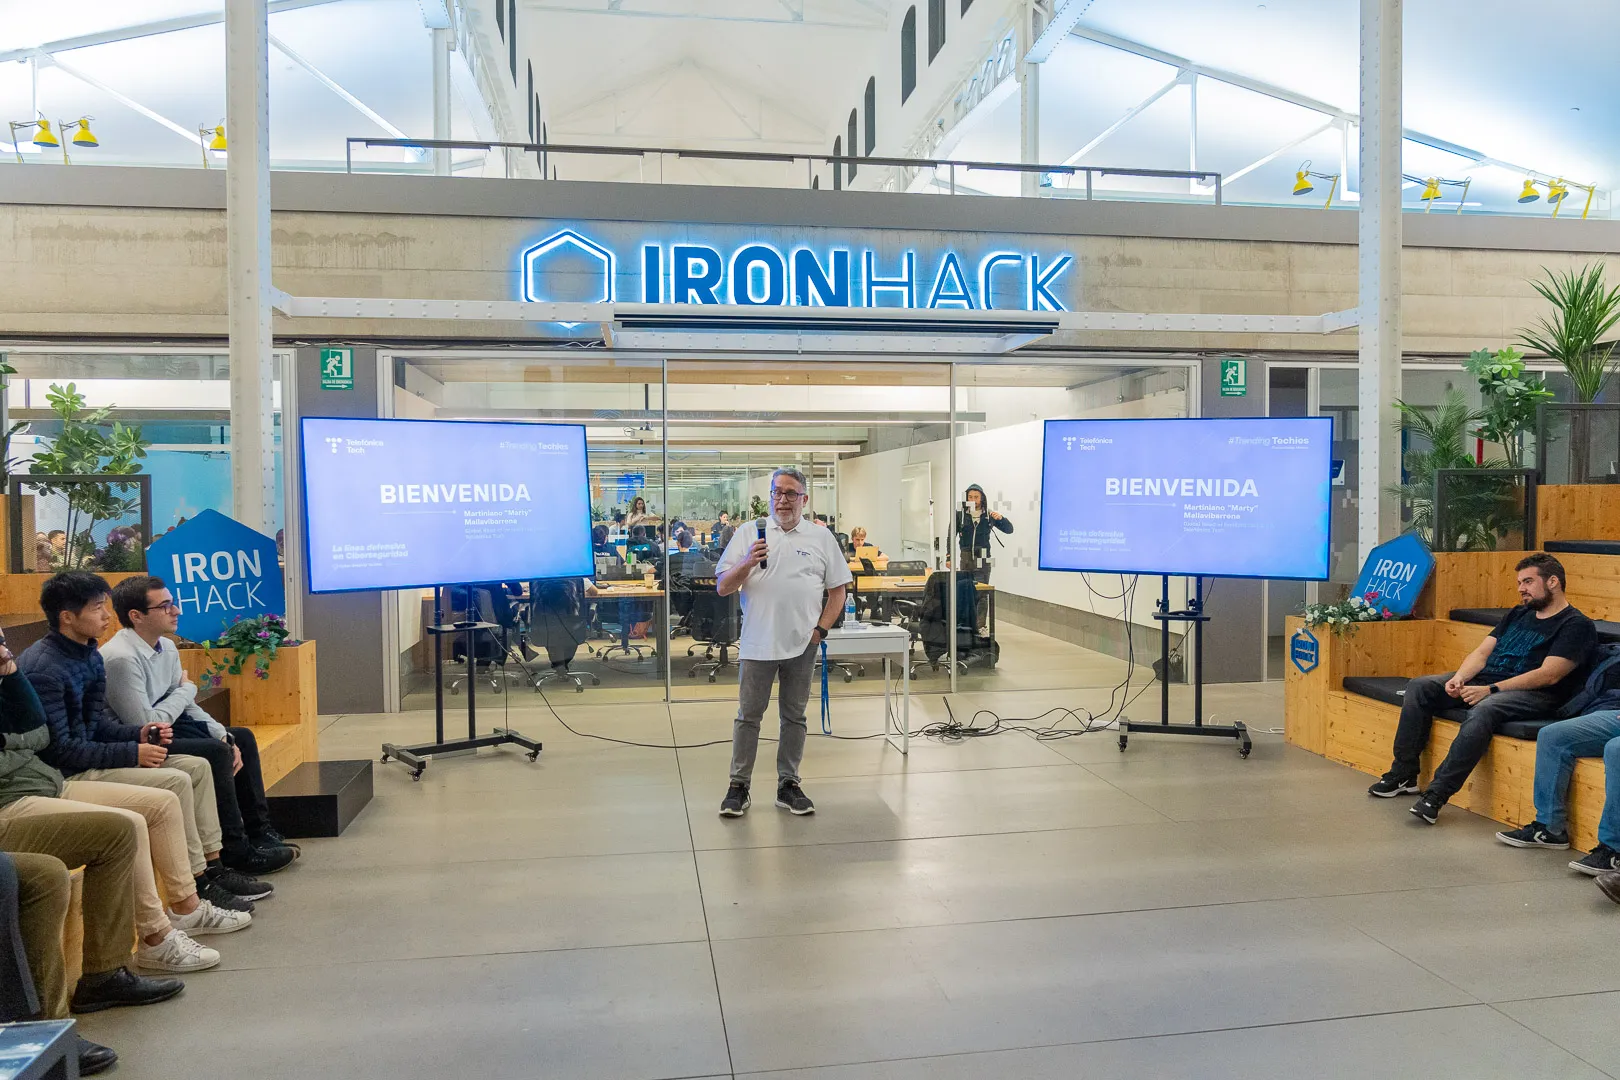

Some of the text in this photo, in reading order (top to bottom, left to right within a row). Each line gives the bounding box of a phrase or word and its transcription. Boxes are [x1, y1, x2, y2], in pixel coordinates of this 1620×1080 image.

[643, 244, 1074, 312] IRONHACK
[1271, 436, 1310, 445] Techies
[380, 483, 532, 504] BIENVENIDA
[1105, 477, 1260, 498] BIENVENIDA
[171, 549, 263, 584] IRON
[1372, 558, 1418, 582] IRON
[176, 580, 267, 616] HACK
[1364, 577, 1408, 601] HACK
